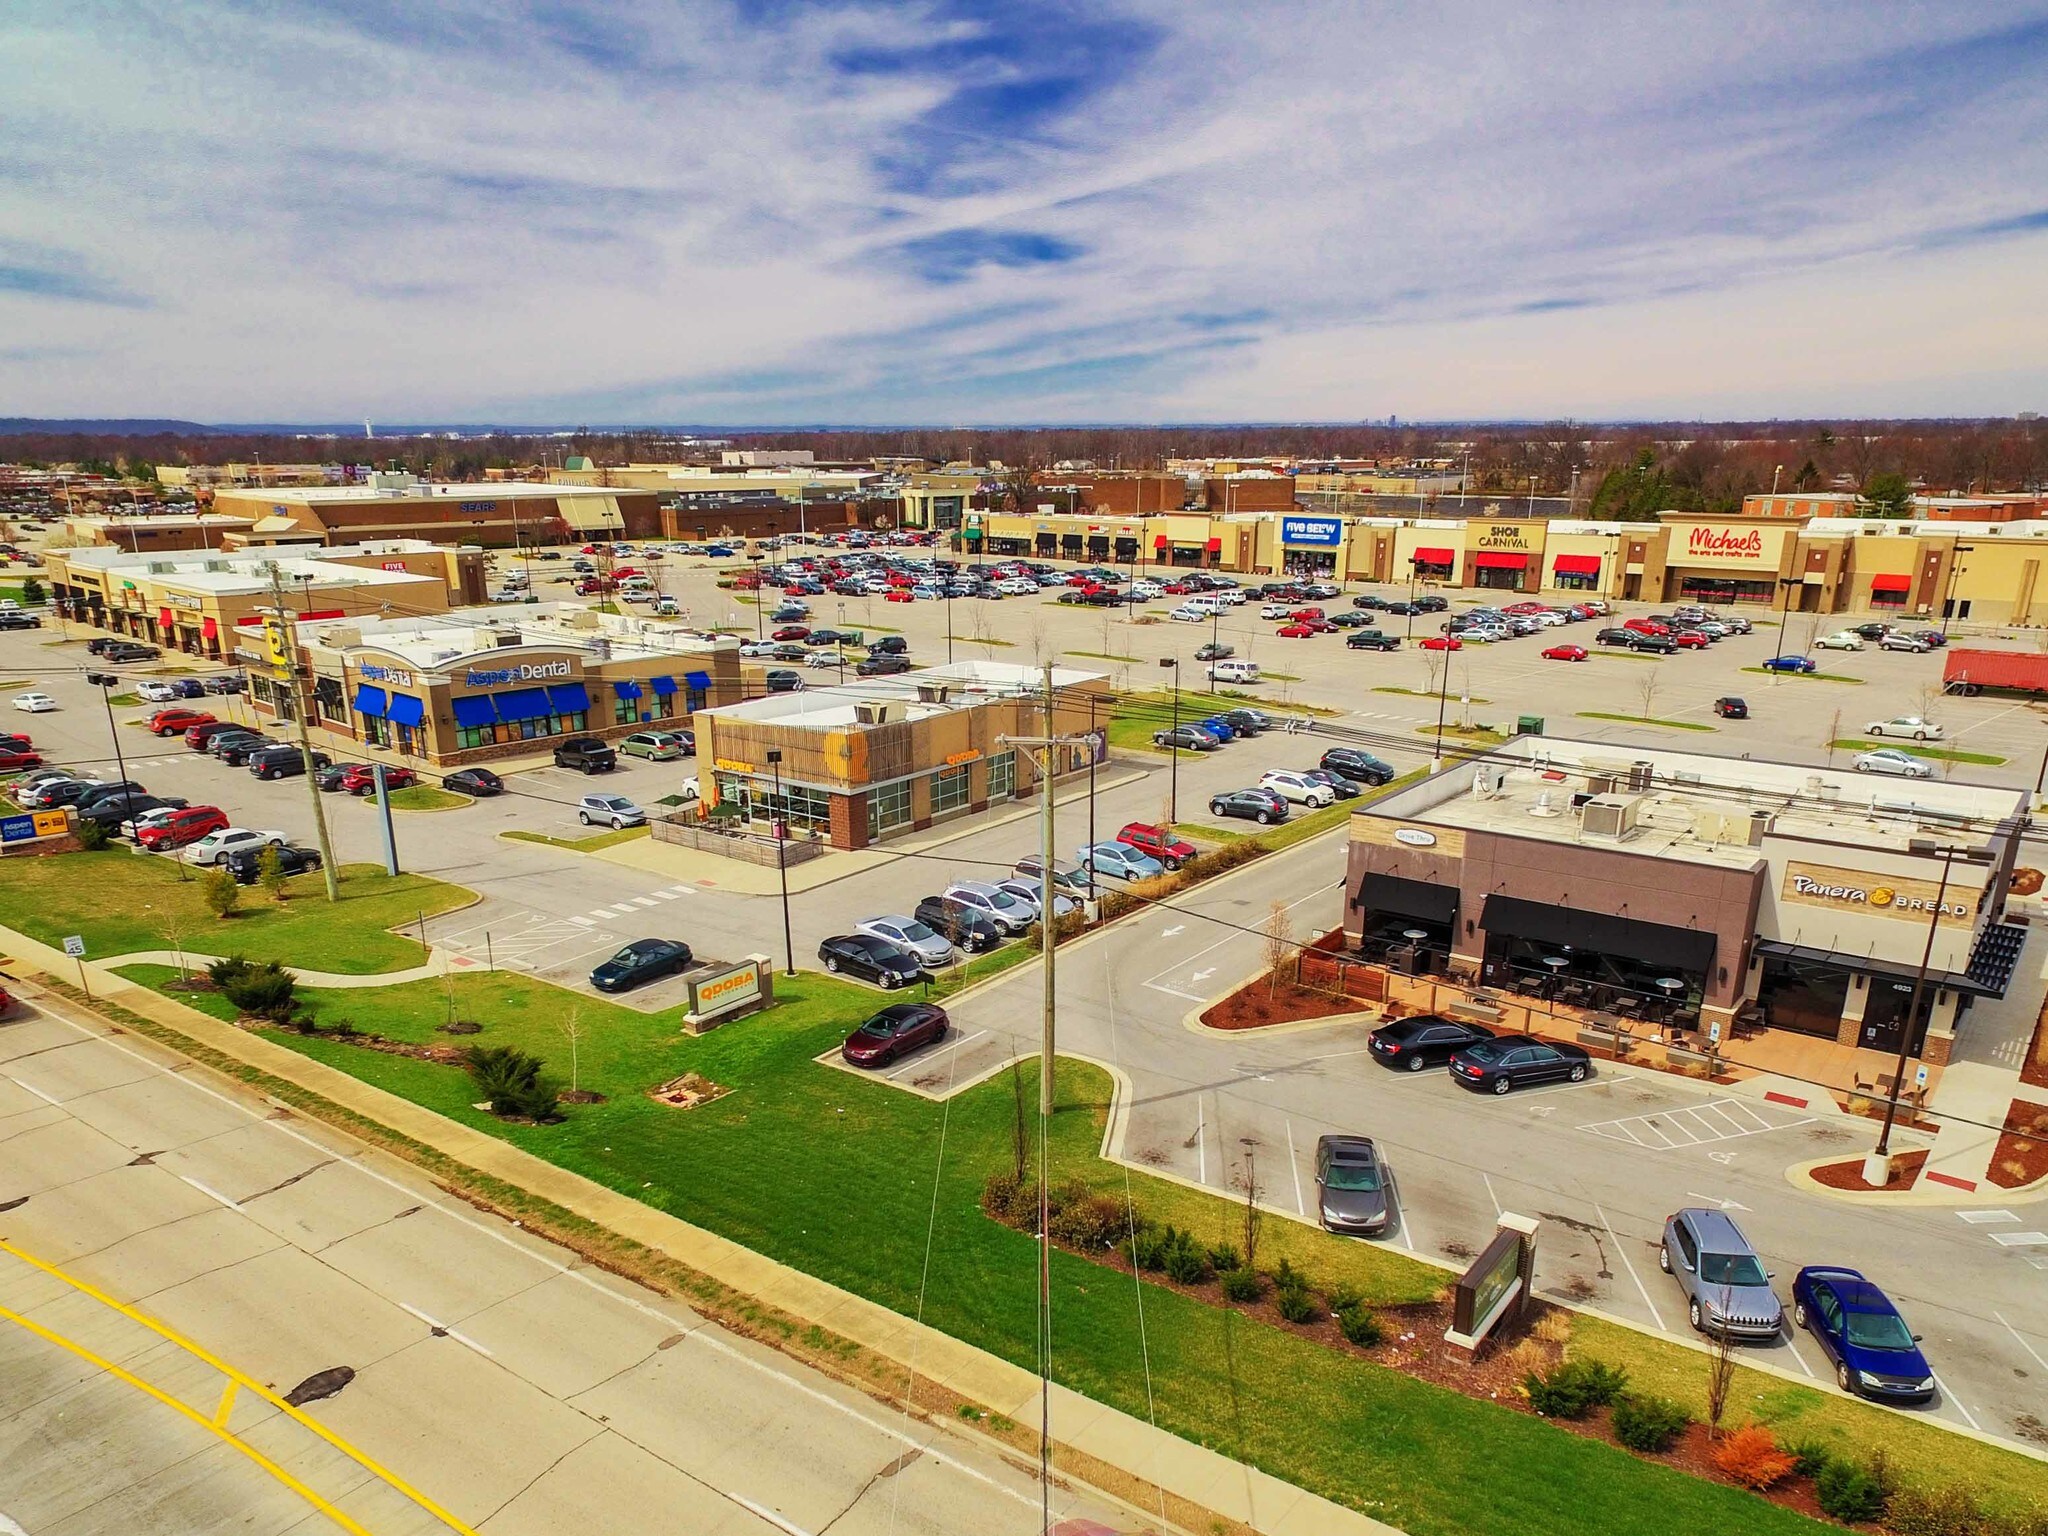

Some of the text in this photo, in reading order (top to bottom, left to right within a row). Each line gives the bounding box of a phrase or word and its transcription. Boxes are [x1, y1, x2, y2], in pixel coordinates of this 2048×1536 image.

[460, 502, 496, 512] SEARS
[1490, 526, 1520, 537] SHOE
[1478, 537, 1529, 549] CARNIVAL
[1689, 527, 1762, 551] Michaels
[385, 562, 404, 570] FIVE
[466, 659, 571, 688] Aspen Dental
[4, 821, 32, 830] Aspen
[4, 829, 33, 837] Dental
[1792, 874, 1968, 917] Panera BREAD
[69, 945, 82, 954] 45
[701, 971, 754, 1000] QDOBA
